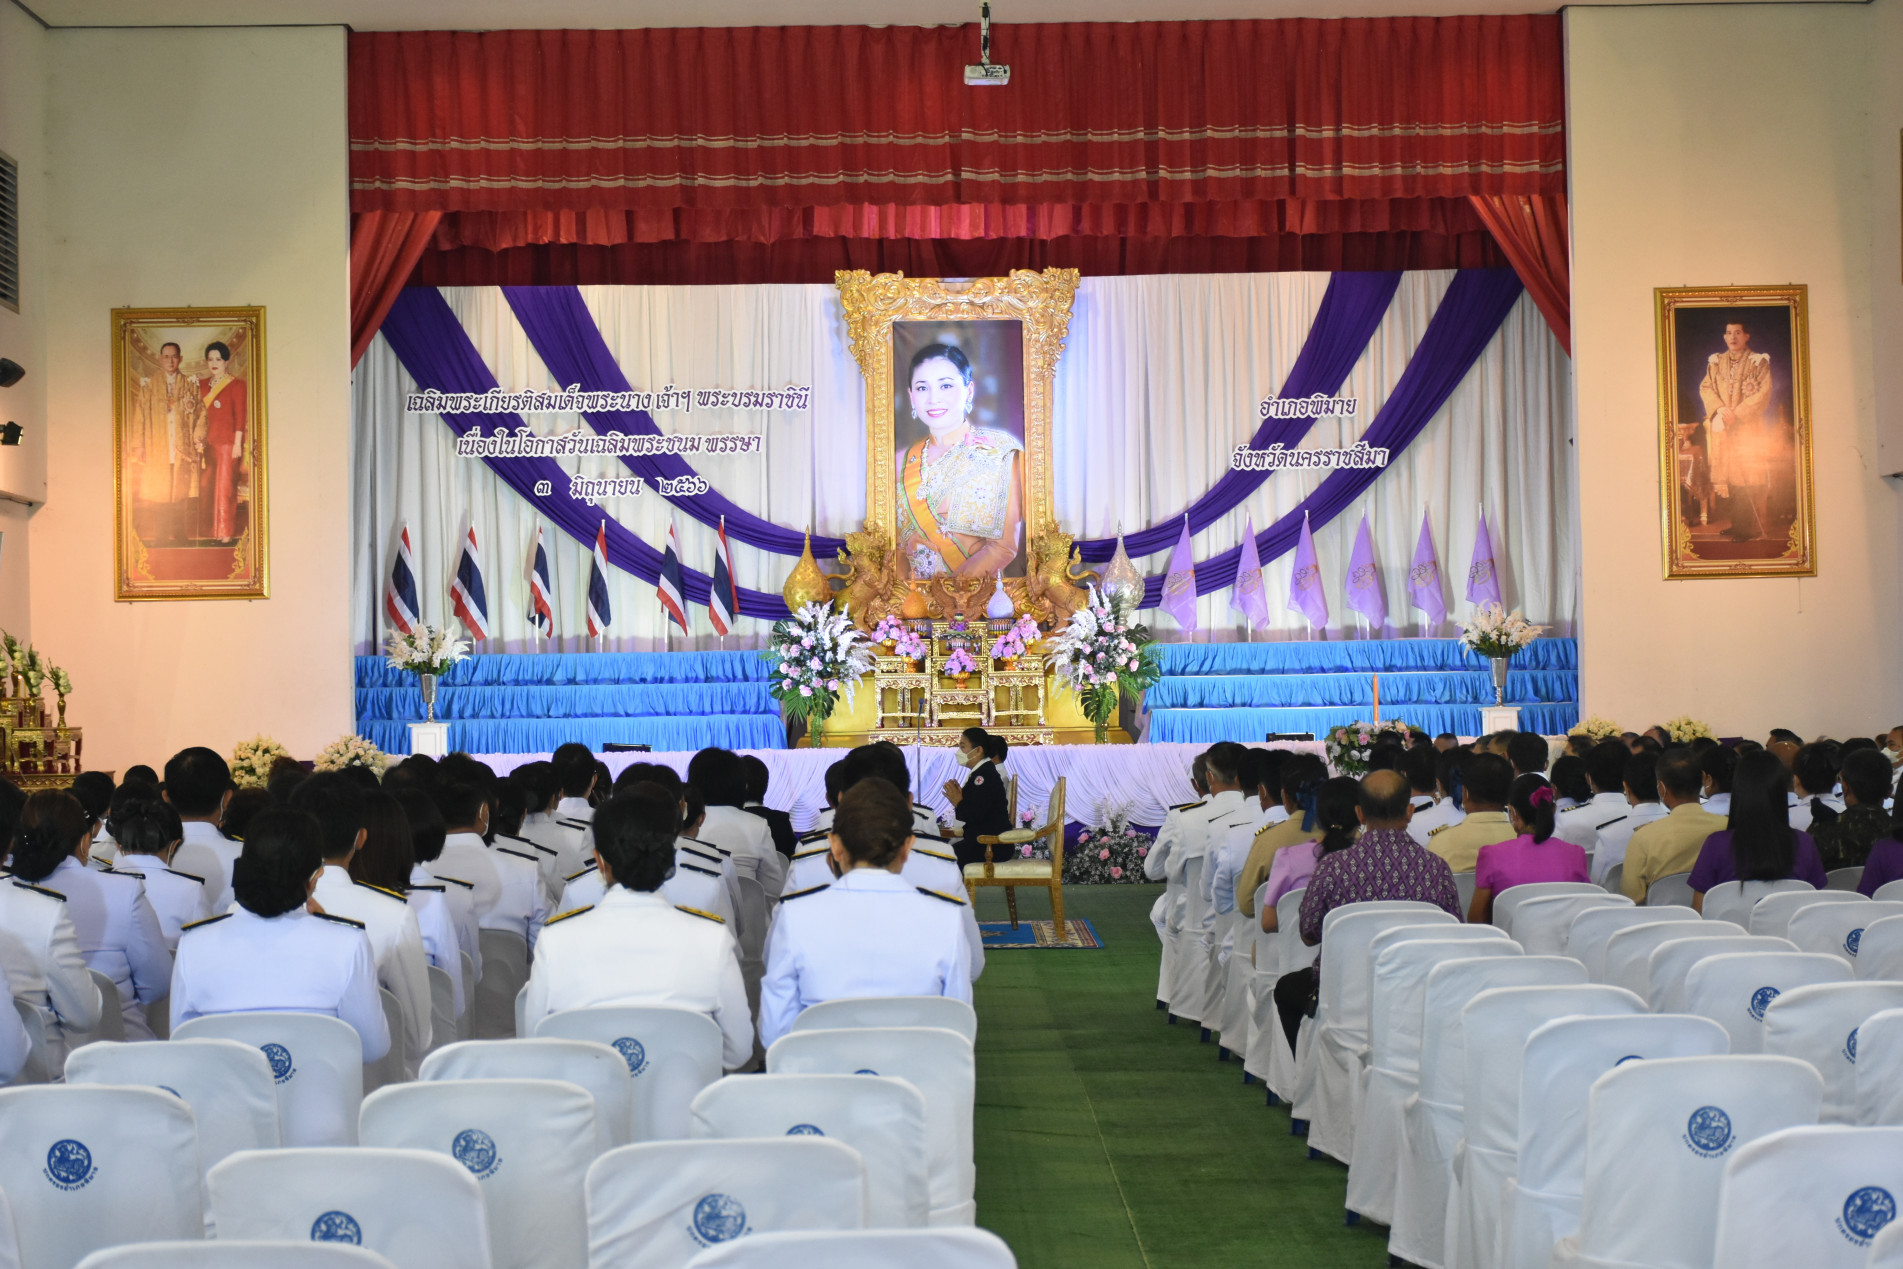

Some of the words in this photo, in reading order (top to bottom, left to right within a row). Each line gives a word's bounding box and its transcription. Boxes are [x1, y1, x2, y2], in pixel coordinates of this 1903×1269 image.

[697, 386, 811, 410] พระบรมราชินี
[1259, 394, 1357, 417] อำเภอพิมาย
[1232, 443, 1388, 468] จังหวัดนครราชสีมา
[536, 482, 550, 494] ๓
[571, 475, 642, 504] มิถุนายน
[659, 476, 709, 494] ๒๕๖๖
